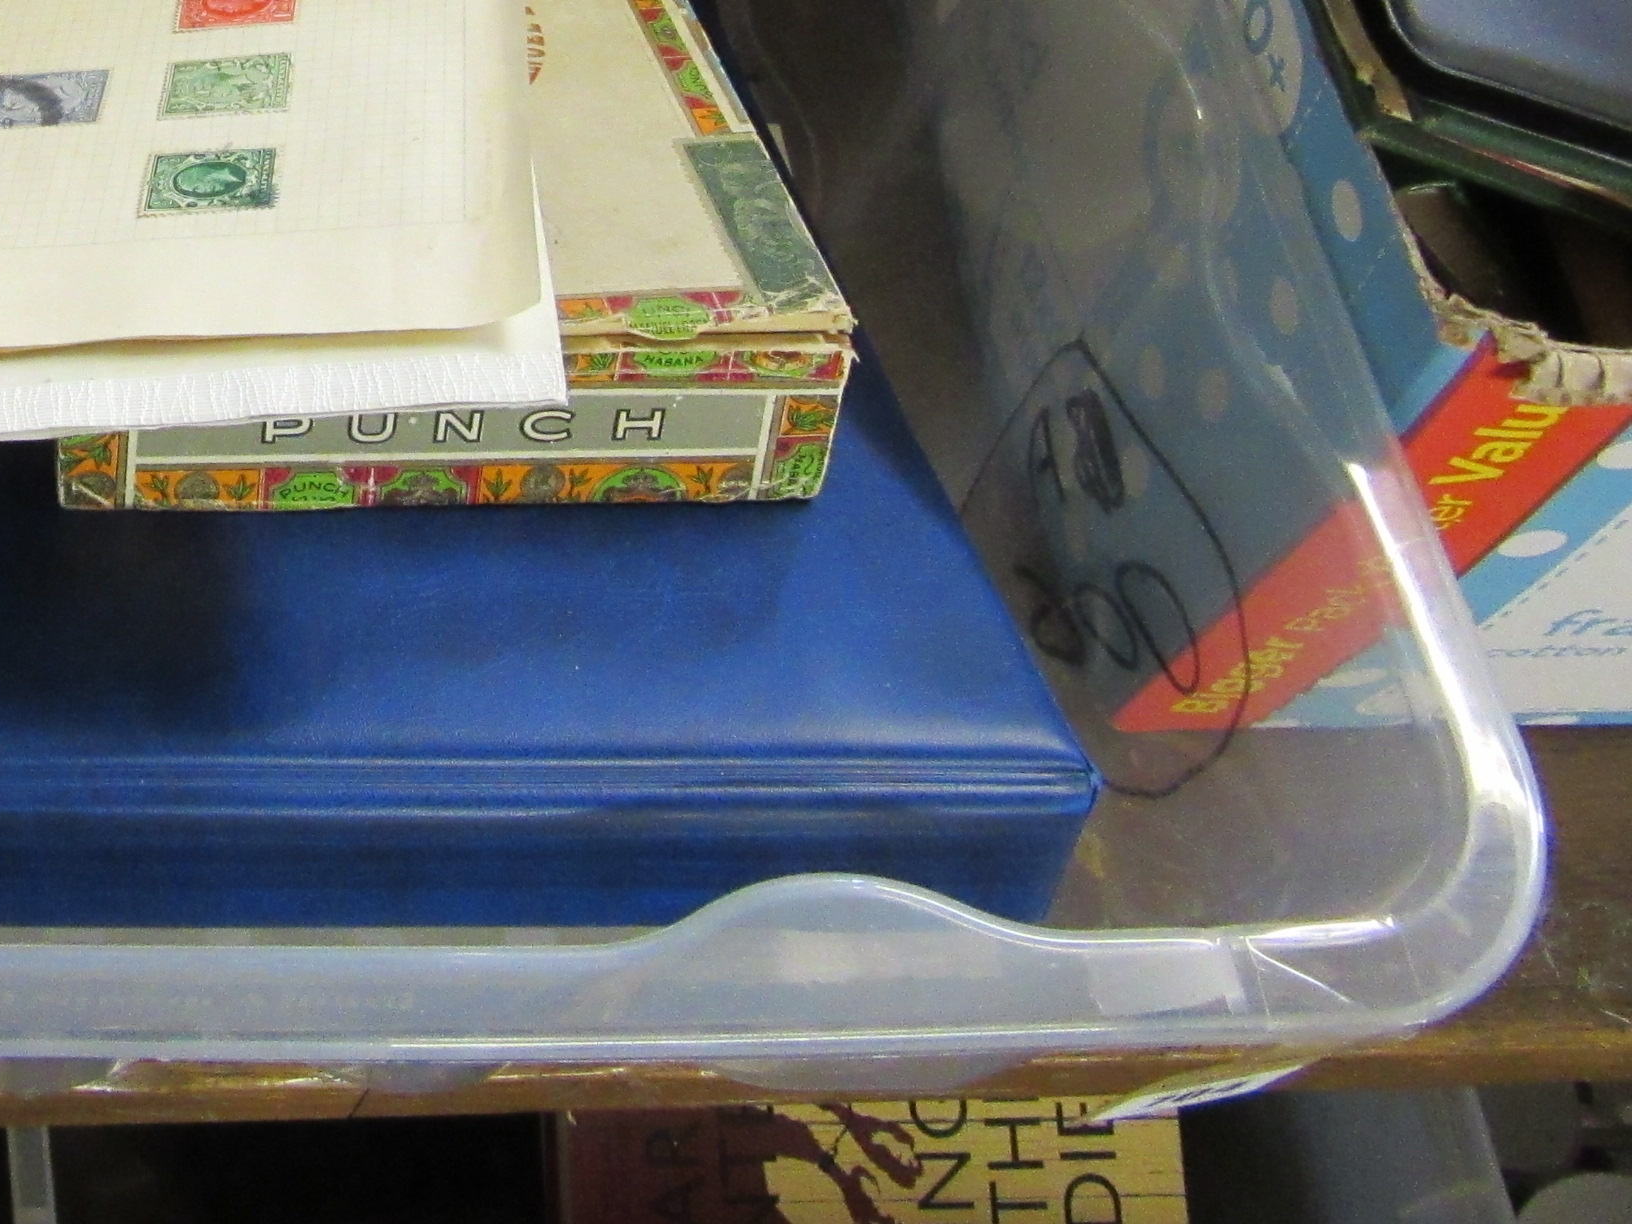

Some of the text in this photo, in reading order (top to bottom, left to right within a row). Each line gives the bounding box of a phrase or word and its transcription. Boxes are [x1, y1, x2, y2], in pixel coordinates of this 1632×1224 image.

[644, 354, 704, 368] HABANA
[259, 406, 666, 445] PUNCH
[278, 480, 350, 501] PUNCH
[1171, 636, 1305, 715] Bigger
[1429, 404, 1571, 486] Valu
[982, 1096, 1048, 1224] TH
